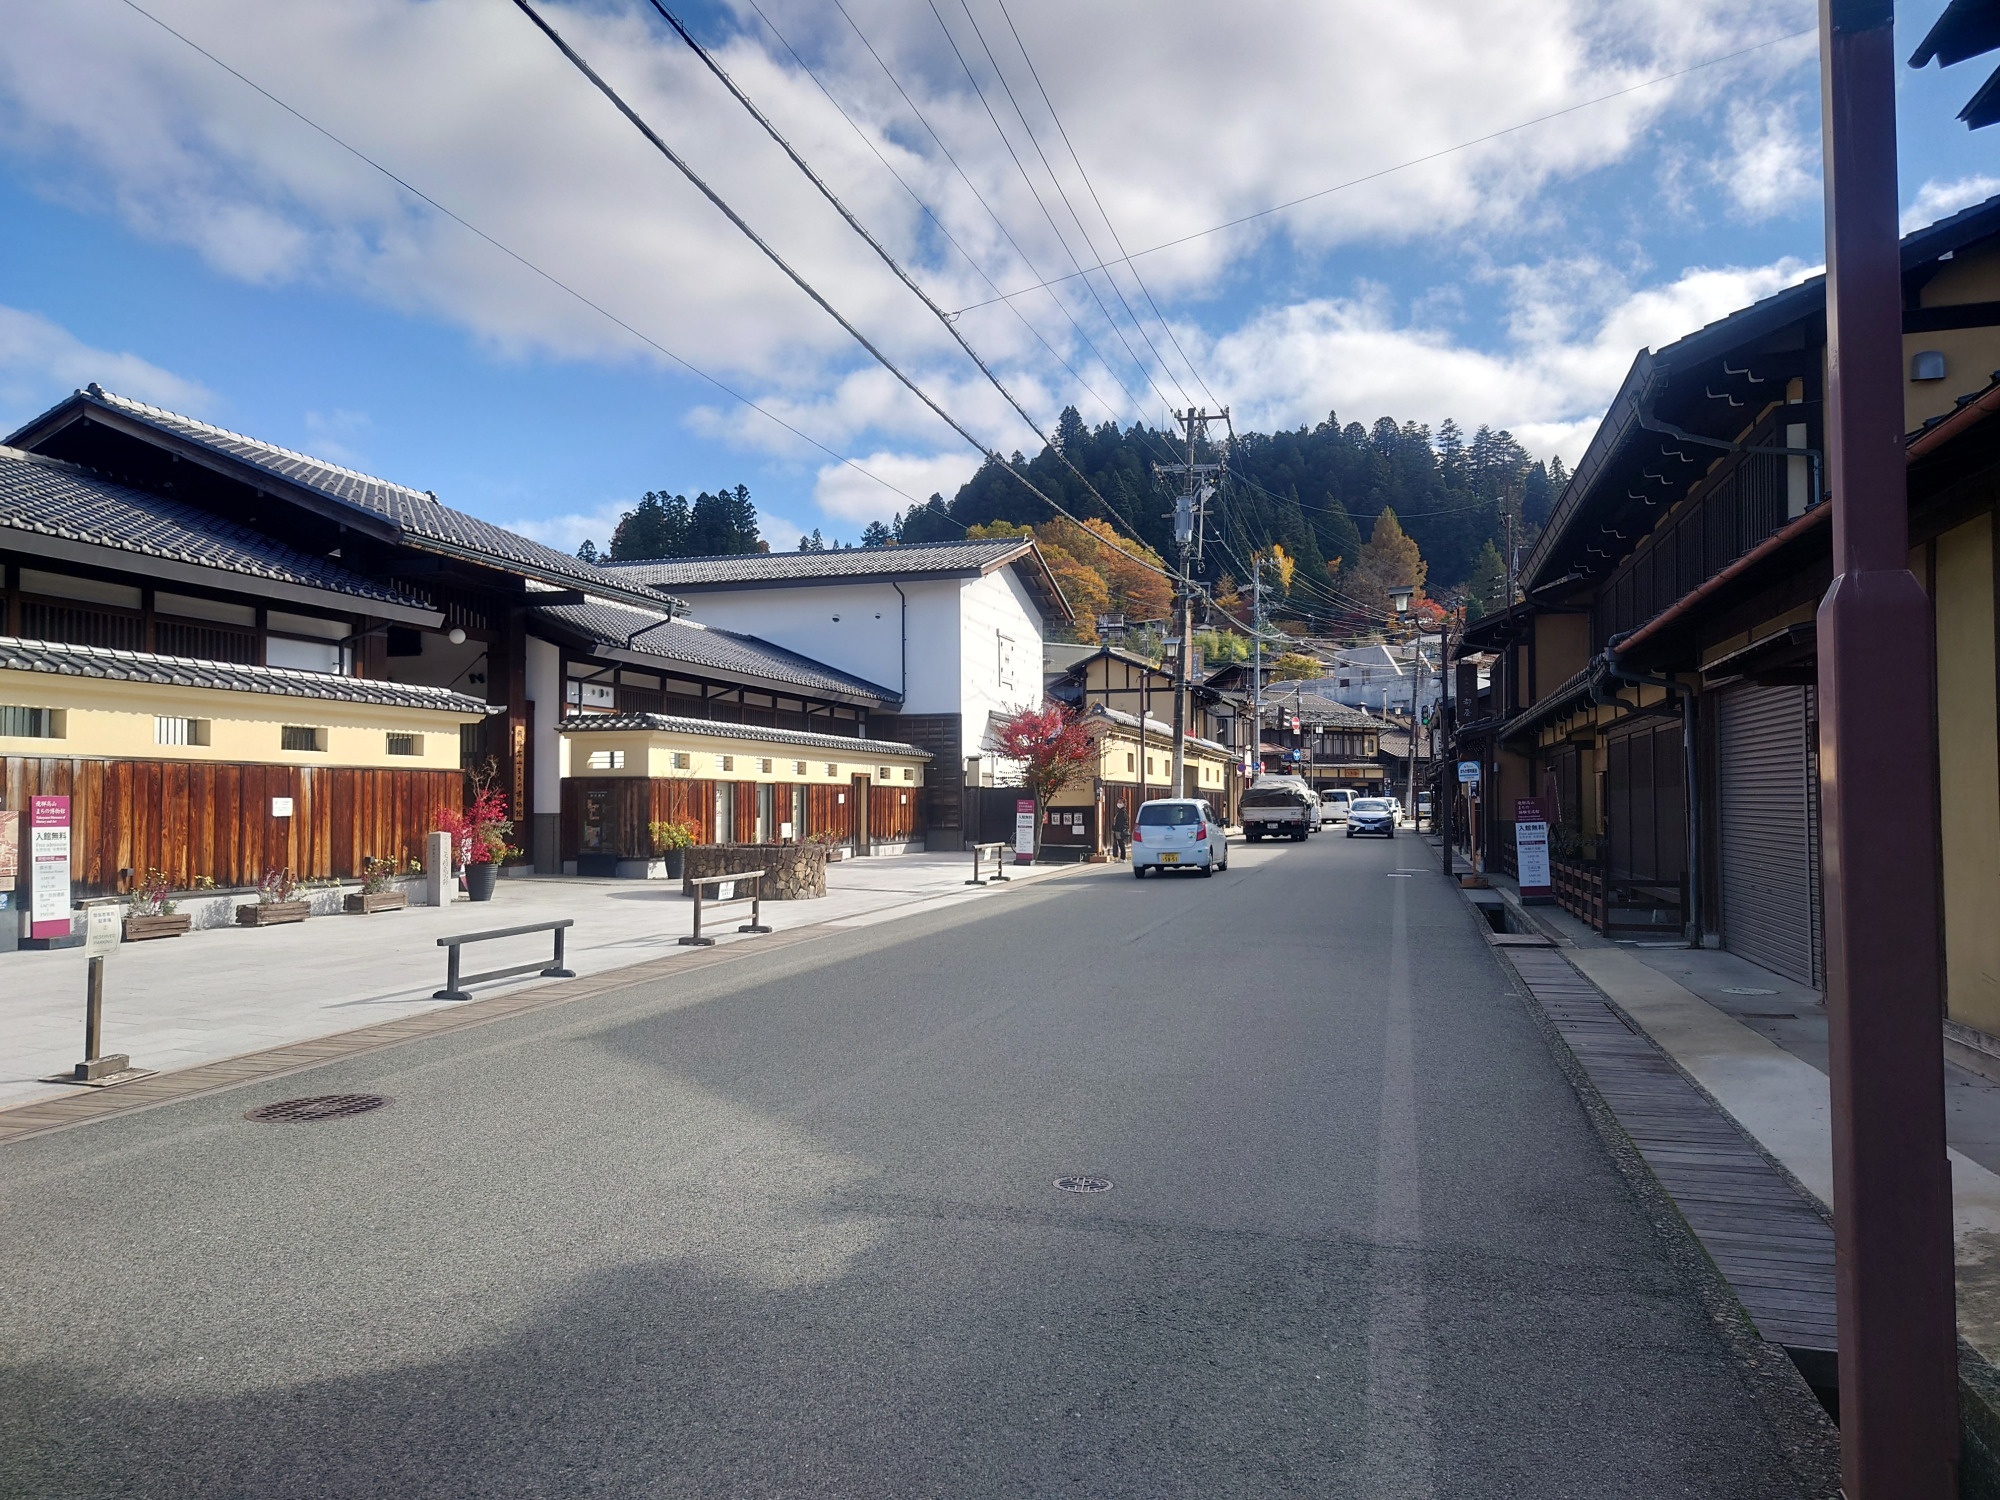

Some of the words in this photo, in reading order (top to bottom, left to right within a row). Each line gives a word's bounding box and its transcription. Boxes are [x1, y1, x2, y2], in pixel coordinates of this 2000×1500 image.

[1518, 824, 1545, 832] 入館無料
[36, 832, 67, 841] 入館無料
